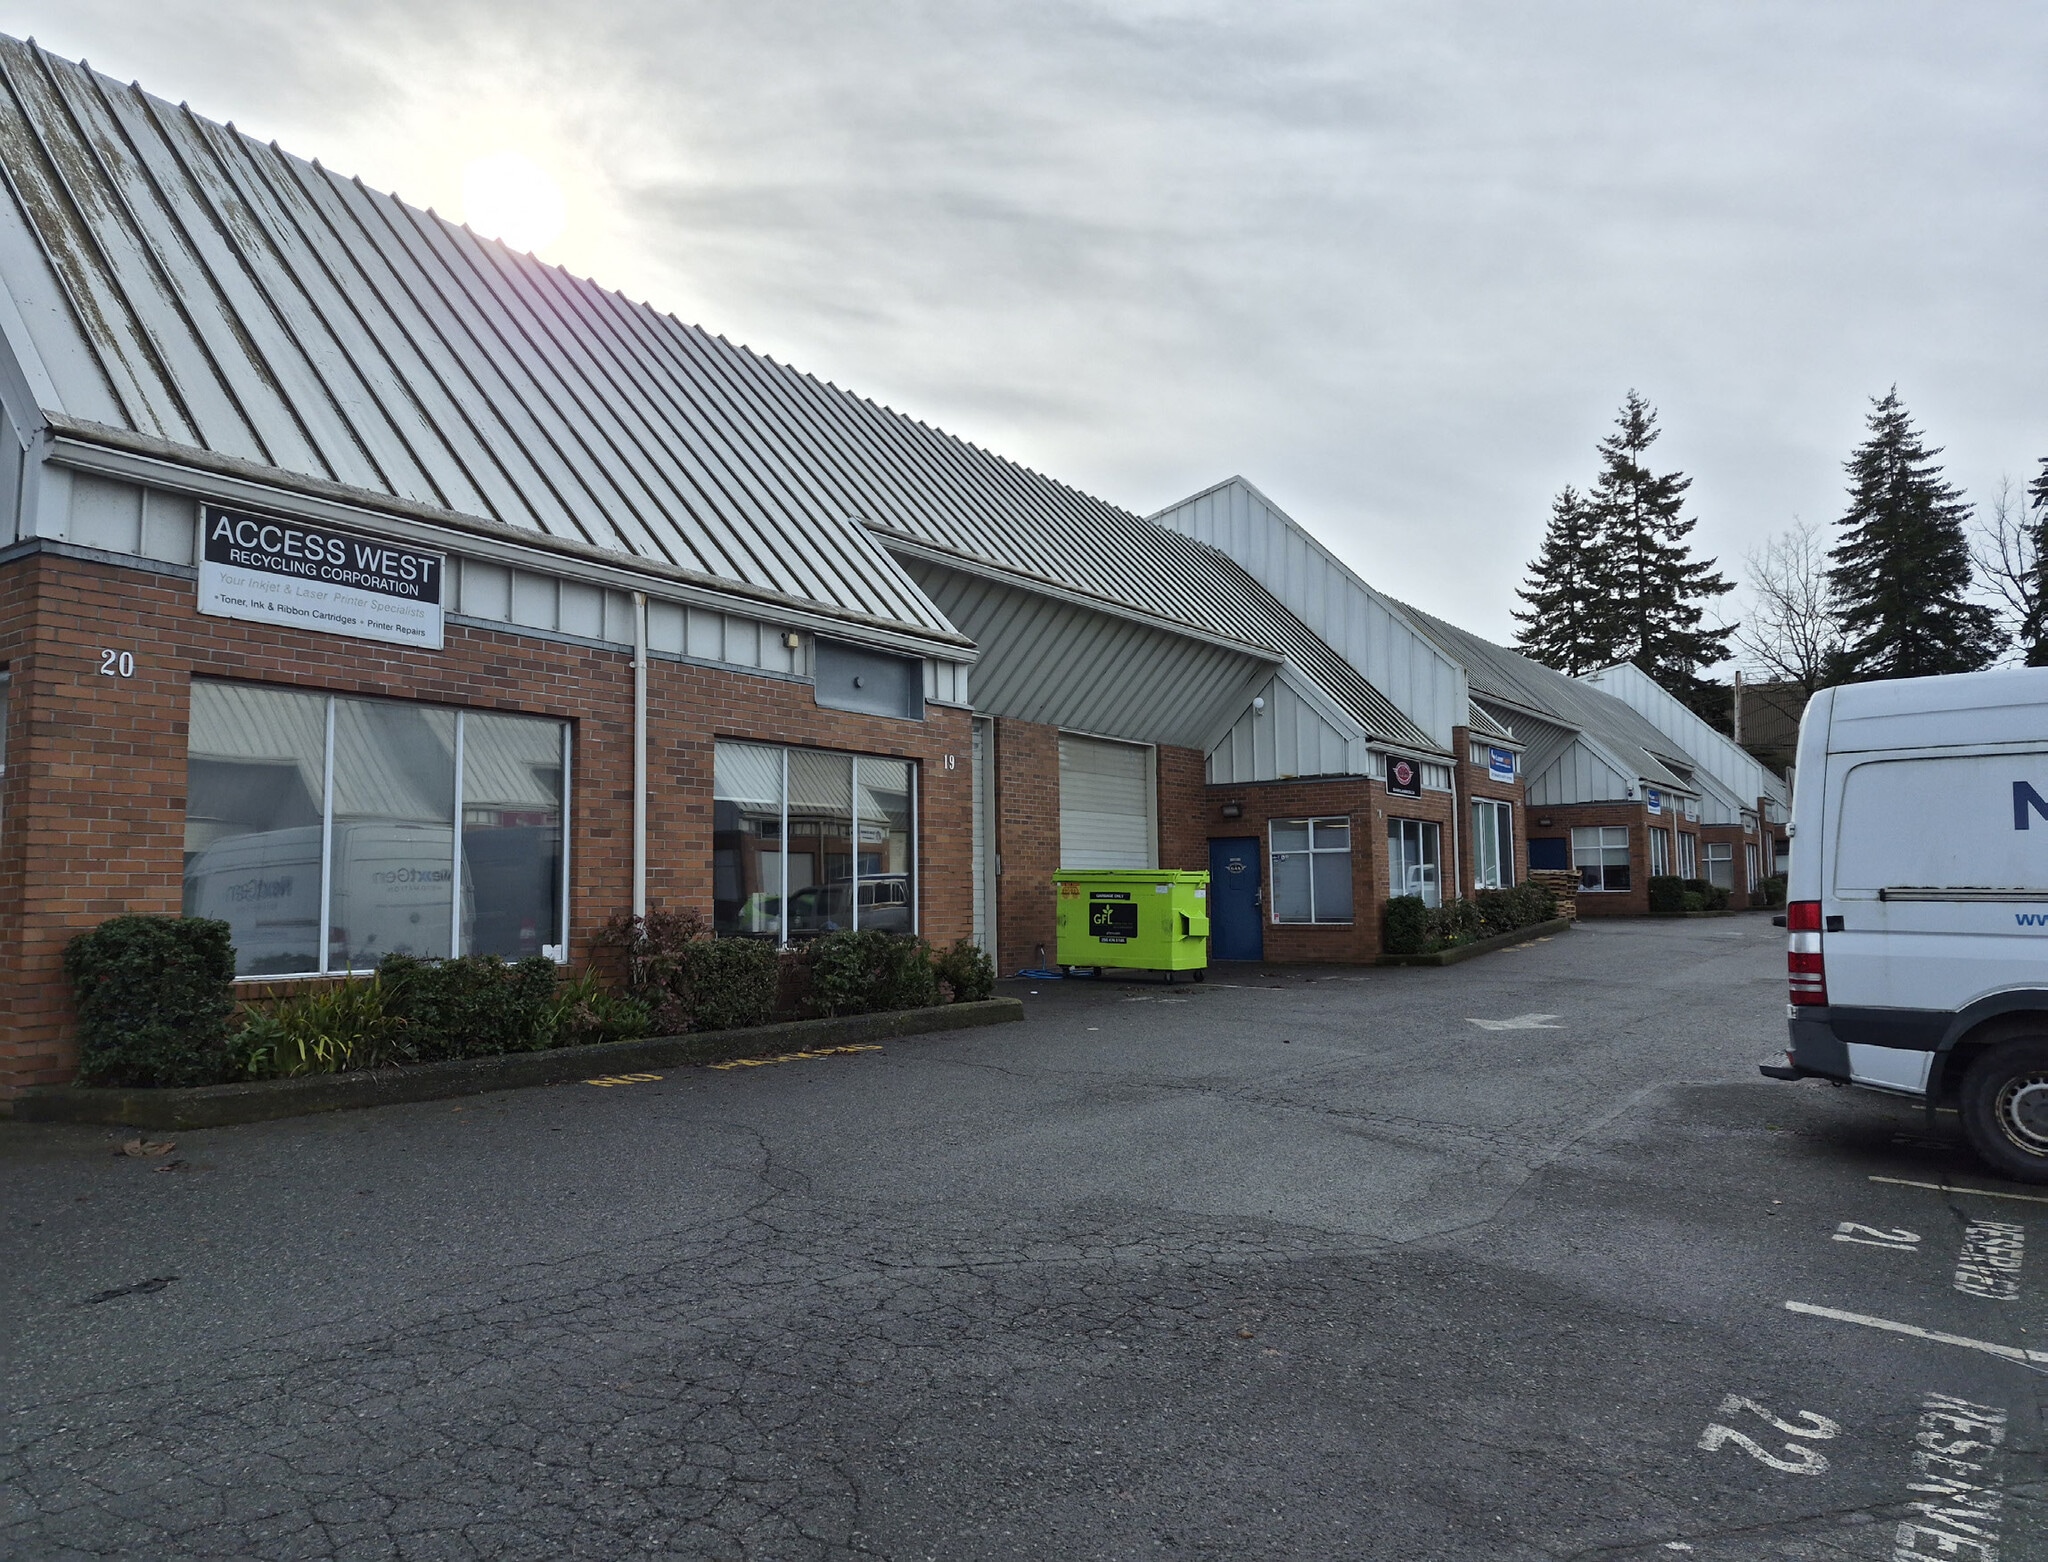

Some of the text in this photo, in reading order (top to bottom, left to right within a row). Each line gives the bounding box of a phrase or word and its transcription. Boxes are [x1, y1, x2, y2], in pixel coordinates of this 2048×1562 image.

[212, 515, 435, 583] ACCESS WEST
[219, 572, 425, 618] Your Inkjet & Laser Printer Specialists
[230, 549, 419, 597] RECYCLING CORPORATION
[220, 594, 426, 637] Toner, Ink & Ribbon Cartridges Printer Repairs
[101, 649, 134, 678] 20
[944, 754, 955, 770] 19
[1093, 909, 1113, 925] GFL
[1831, 1221, 1922, 1252] 21
[1697, 1393, 1842, 1476] 22
[1893, 1391, 2008, 1562] RESERVE
